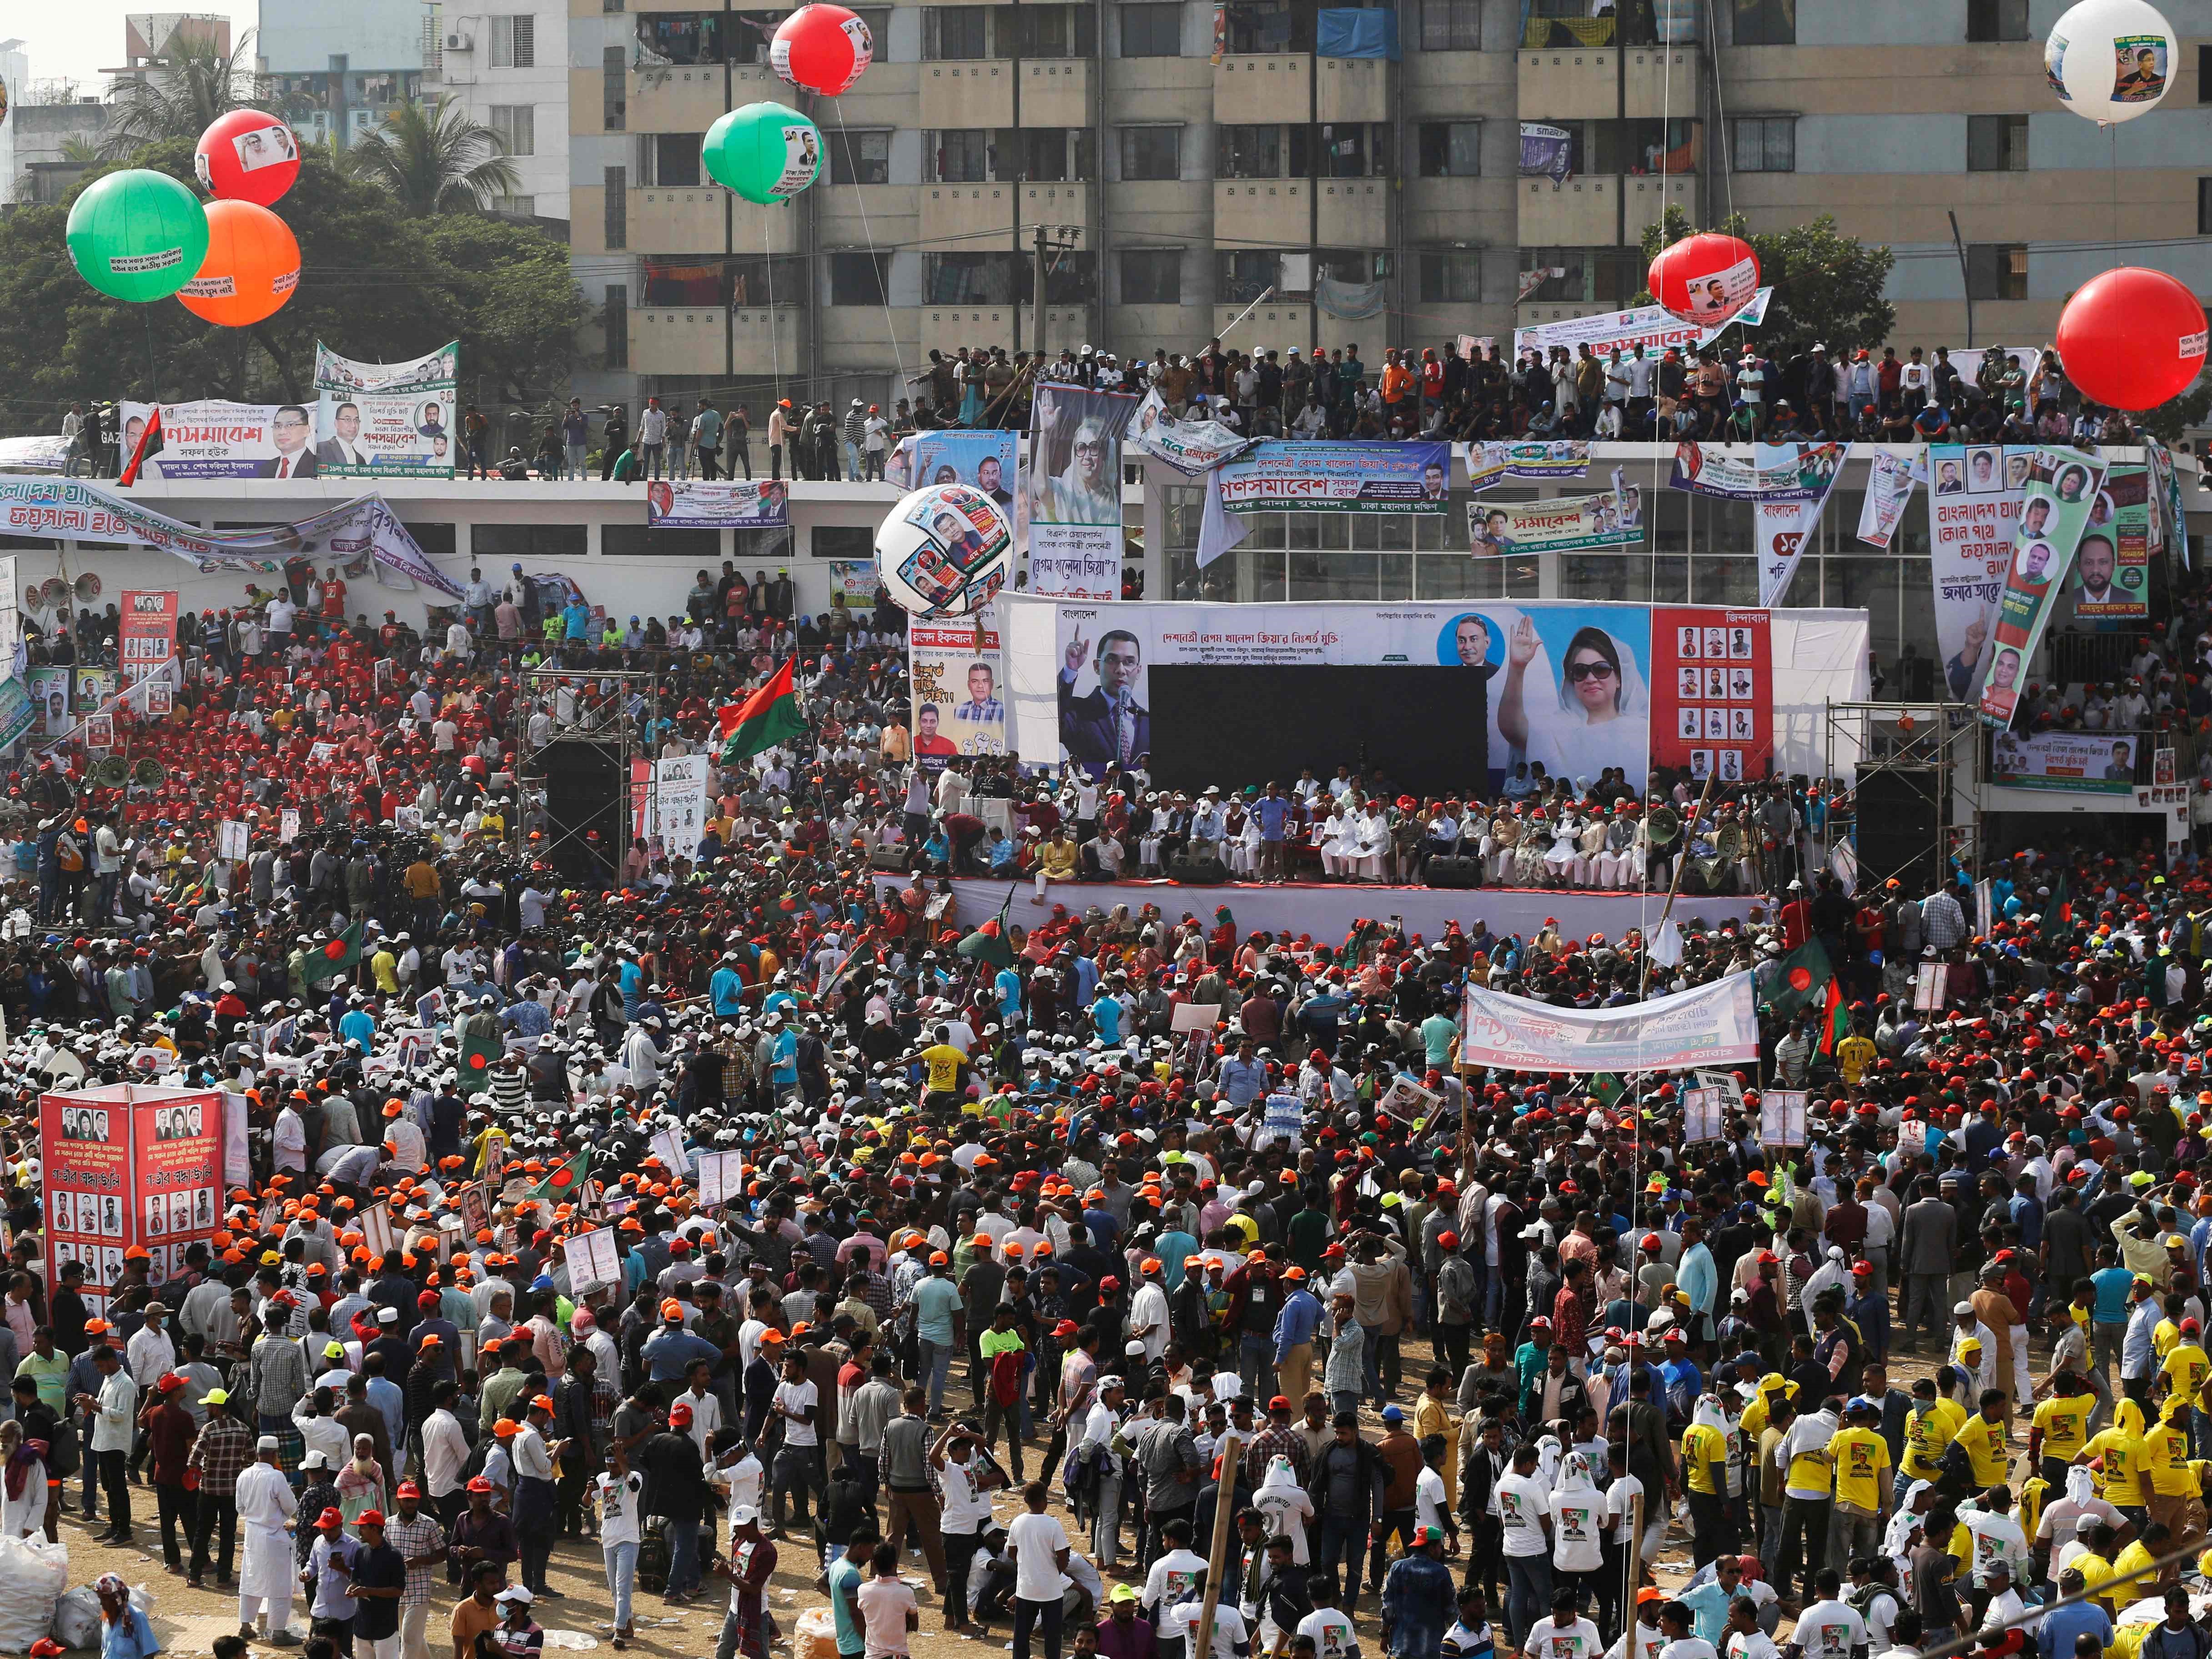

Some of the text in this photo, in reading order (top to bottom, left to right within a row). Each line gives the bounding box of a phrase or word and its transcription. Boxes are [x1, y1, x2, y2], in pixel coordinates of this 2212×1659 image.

[161, 248, 181, 258] অধিকার
[141, 261, 160, 270] জাতীয়
[163, 257, 181, 266] সরকার
[206, 285, 233, 298] ঘুম নাই
[364, 433, 417, 448] গণসমাবেশ
[181, 447, 229, 458] সফল হউক
[231, 462, 254, 470] ইসলাম
[1257, 457, 1388, 470] দেশনেত্রী বেগম খালেদা জিয়া'র
[1220, 478, 1359, 498] গণসমাবেশ সফল
[1333, 488, 1358, 497] হোক
[1703, 487, 1815, 498] ঢাকা বিএনপি
[1361, 502, 1378, 511] ঢাকা
[1381, 502, 1411, 511] মহানগর
[1413, 501, 1437, 511] দক্ষিণ
[1764, 504, 1801, 518] বাংলাদেশ
[1938, 503, 1996, 522] বাংলাদেশ
[10, 506, 86, 531] ফয়সালা
[1513, 513, 1580, 530] সমাবেশ
[1046, 529, 1067, 538] বিএনপি
[1939, 525, 1994, 543] কোন পথে
[1058, 540, 1083, 549] প্রধানমন্ত্রী
[1086, 541, 1111, 550] দেশনেত্রী
[1033, 559, 1081, 579] বেগম খালেদা
[1941, 585, 1972, 601] জনাব
[1062, 609, 1097, 621] বাংলাদেশ
[1725, 610, 1769, 624] জিন্দাবাদ
[913, 630, 972, 644] রাশেদ ইকবাল
[1163, 630, 1338, 646] দেশনেত্রী বেগম খালেদা জিয়া'র নিঃশর্ত মুক্তি
[914, 676, 935, 694] মুক্তি
[1712, 1077, 1729, 1086] HUMAN
[1275, 1496, 1290, 1508] UNITED
